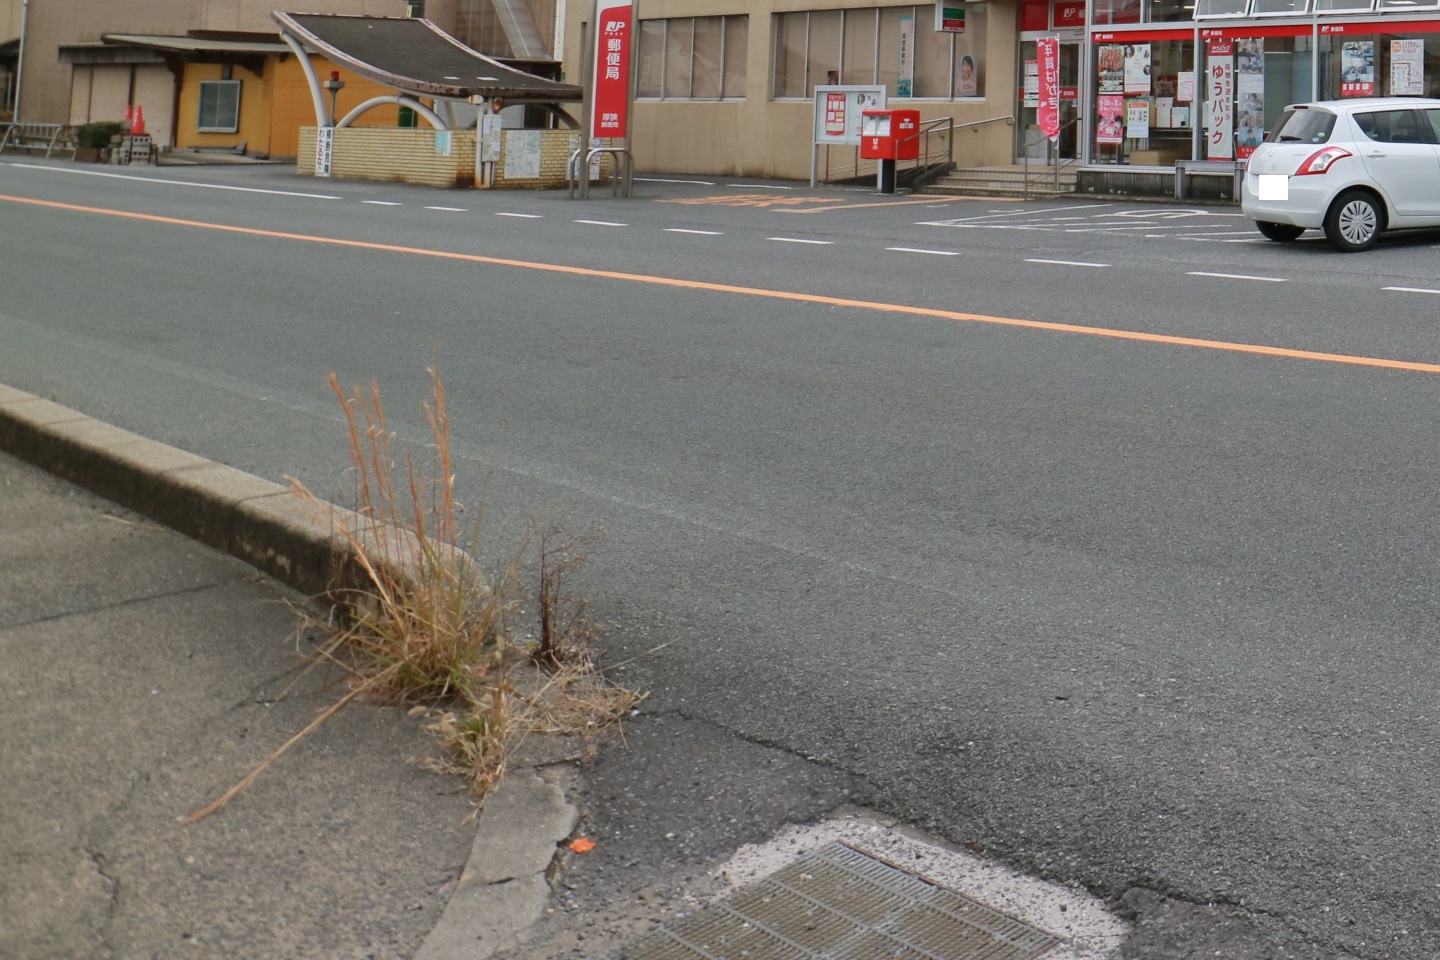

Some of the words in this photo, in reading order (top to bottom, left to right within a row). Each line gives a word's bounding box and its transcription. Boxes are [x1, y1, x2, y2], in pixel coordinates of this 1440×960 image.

[605, 38, 622, 81] 郵便局
[1212, 65, 1224, 144] ゆうパック
